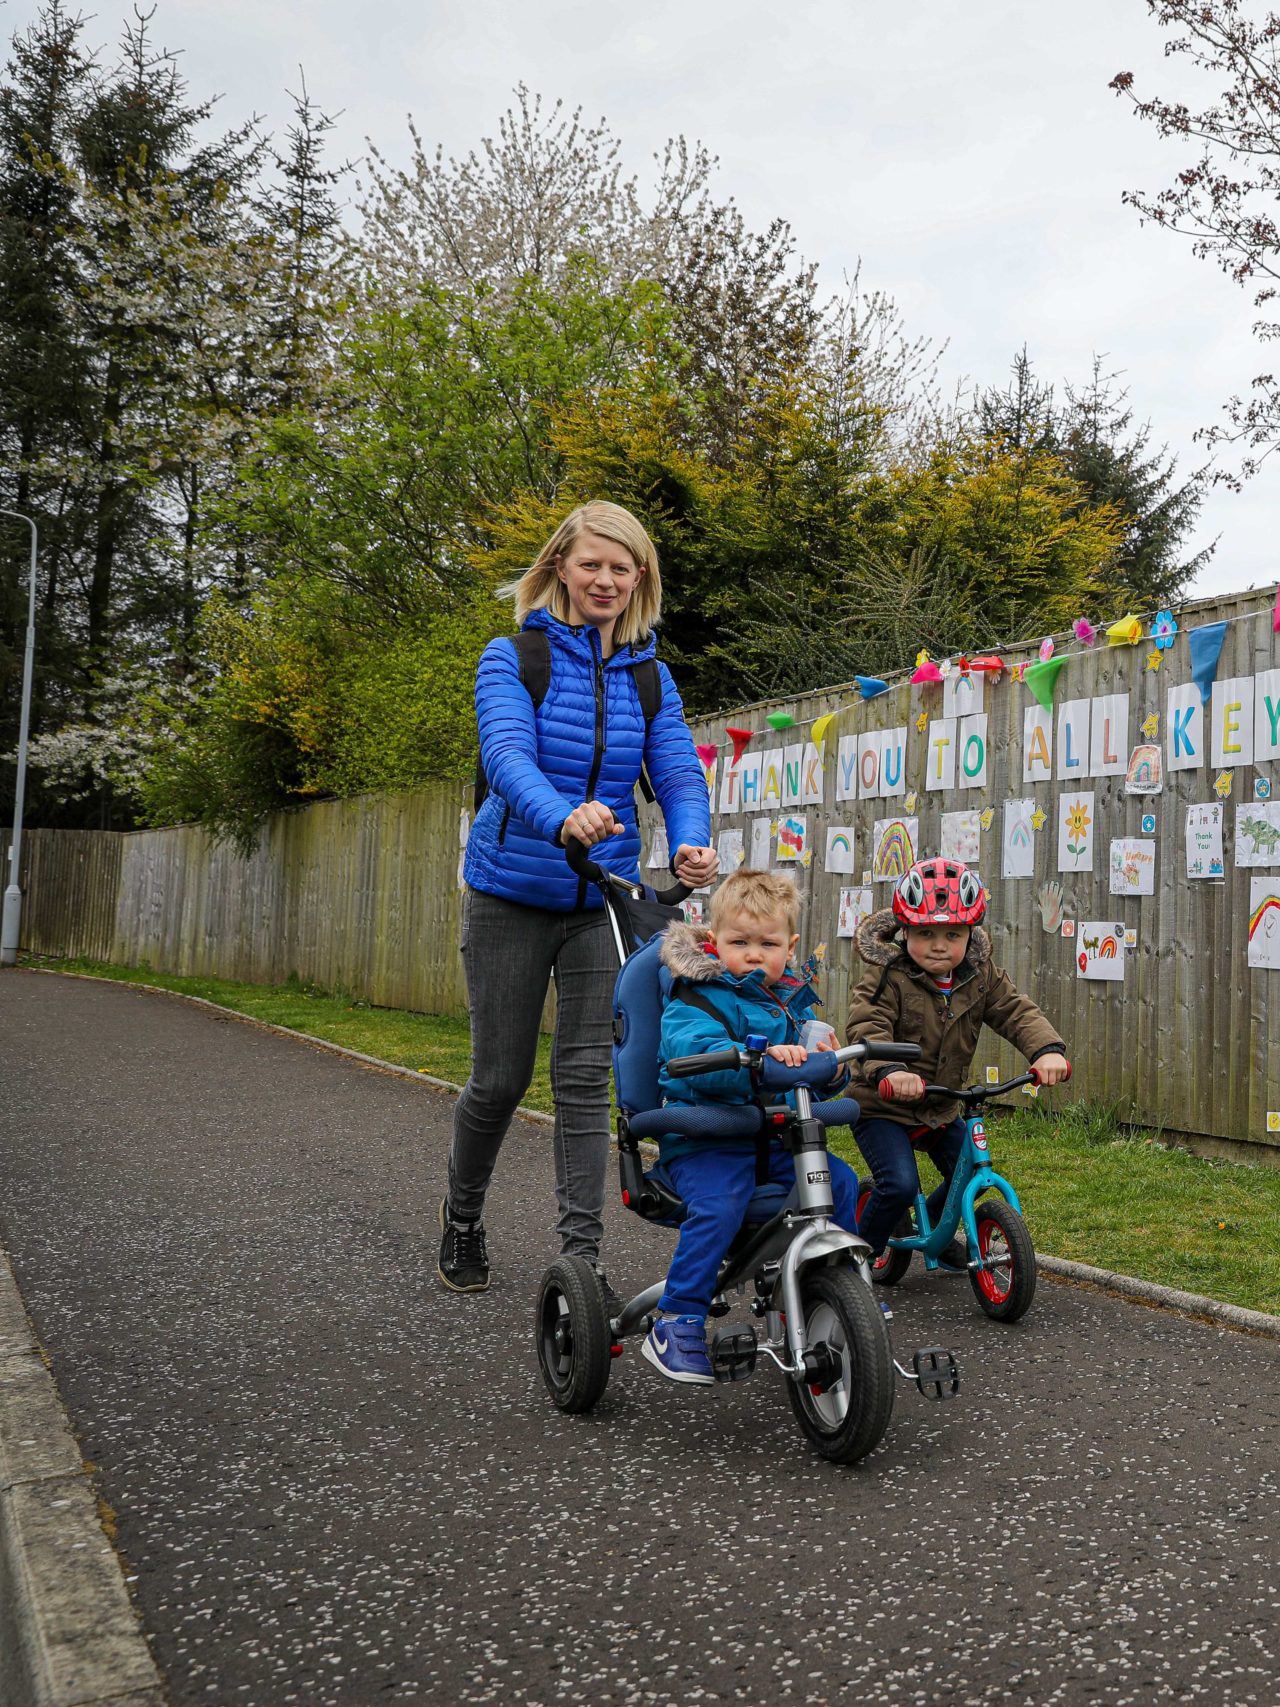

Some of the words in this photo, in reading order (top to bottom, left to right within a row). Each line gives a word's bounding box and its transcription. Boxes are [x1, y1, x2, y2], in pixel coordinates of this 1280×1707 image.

[725, 758, 819, 805] THANK
[841, 746, 902, 791] YOU
[933, 734, 985, 779] TO
[1027, 718, 1117, 771] ALL
